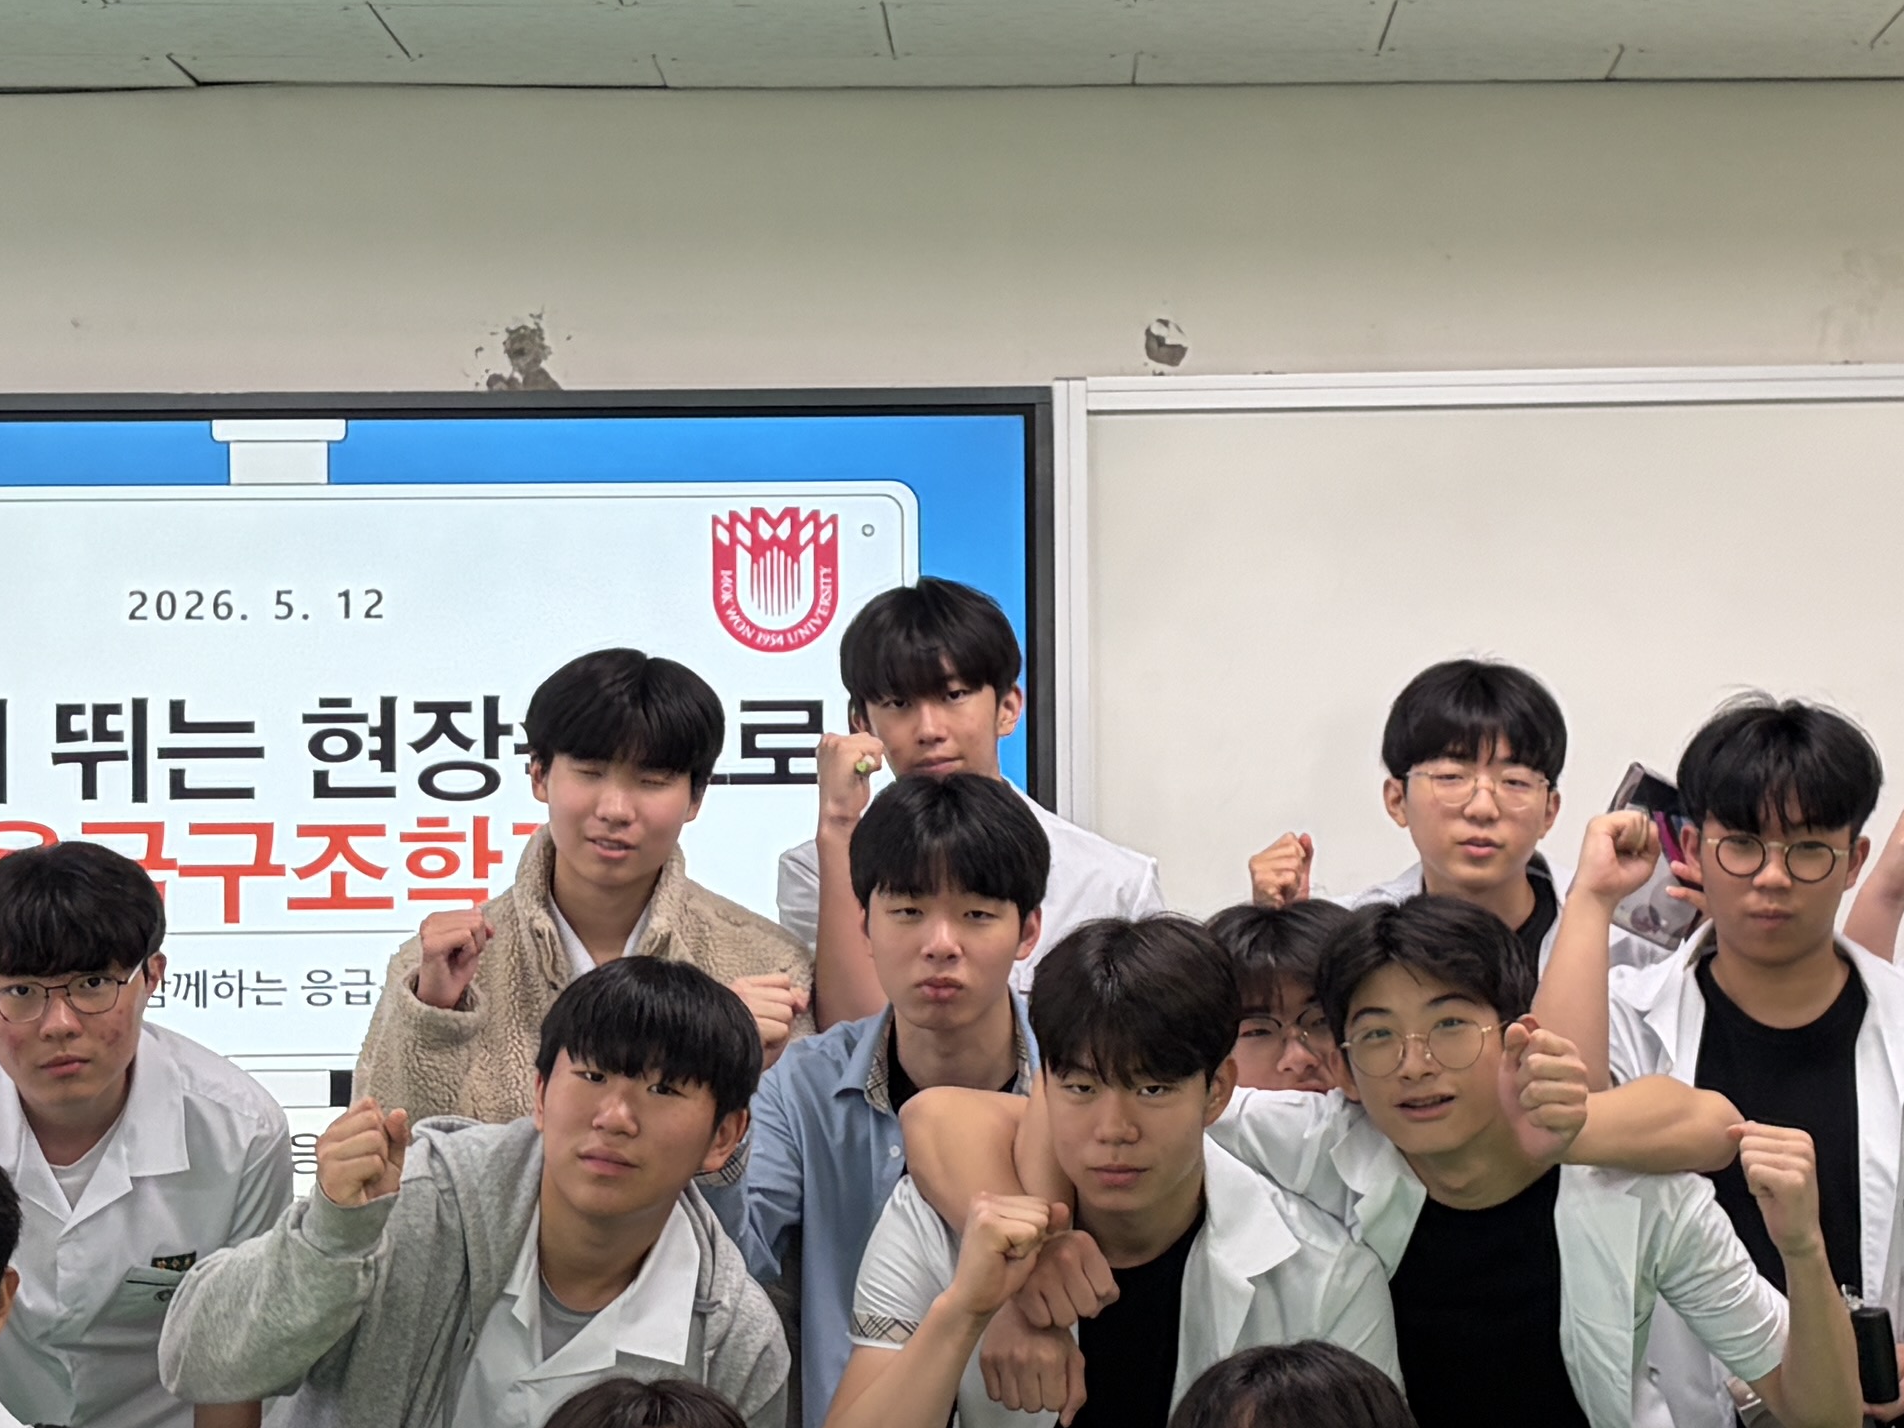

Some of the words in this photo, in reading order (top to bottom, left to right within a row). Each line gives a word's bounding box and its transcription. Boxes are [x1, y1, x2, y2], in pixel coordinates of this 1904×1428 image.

[127, 589, 248, 622] 2026.
[274, 589, 310, 621] 5.
[337, 588, 385, 620] 12
[756, 632, 785, 647] 1954
[787, 565, 833, 645] UNIVERSITY
[51, 697, 265, 804] 뛰는
